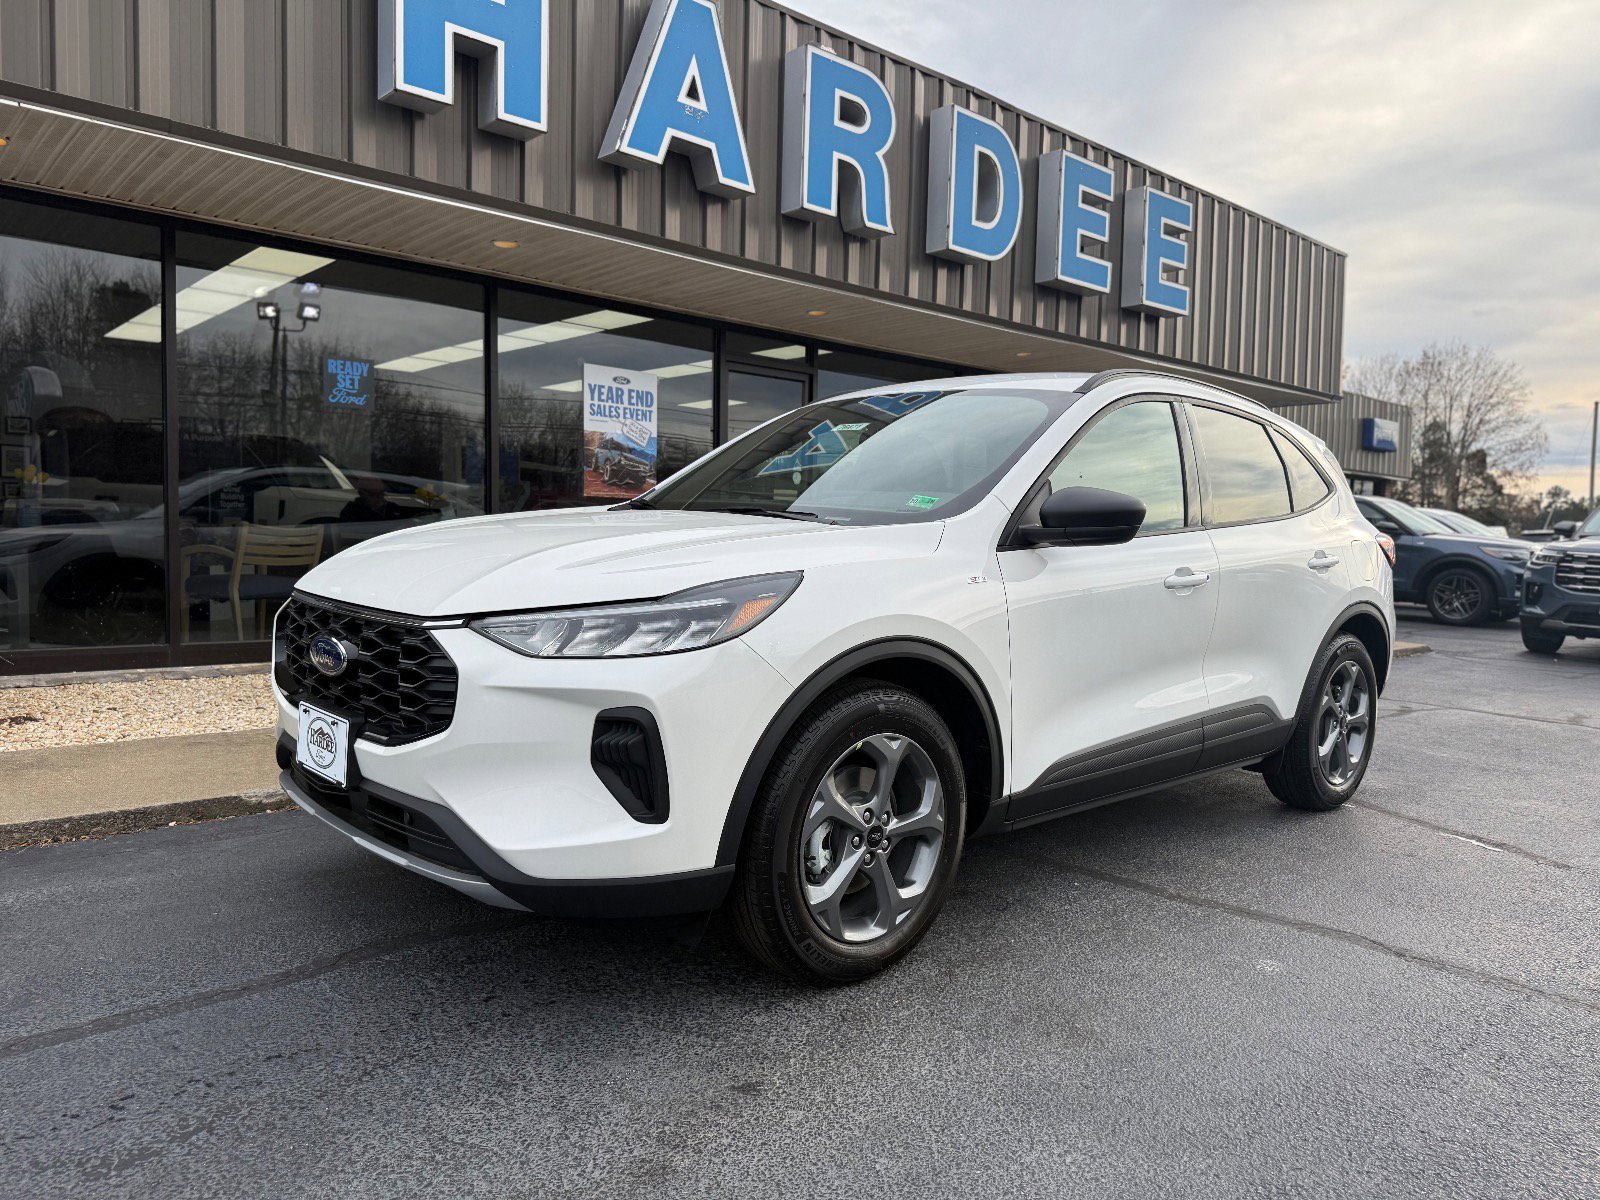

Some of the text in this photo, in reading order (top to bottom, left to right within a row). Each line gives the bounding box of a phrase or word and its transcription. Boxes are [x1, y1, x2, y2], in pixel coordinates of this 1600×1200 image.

[328, 359, 369, 377] READY
[337, 375, 360, 389] SET
[328, 388, 369, 405] Ford
[588, 383, 654, 408] YEAR END
[589, 403, 653, 423] SALES EVENT
[313, 642, 337, 667] Ford
